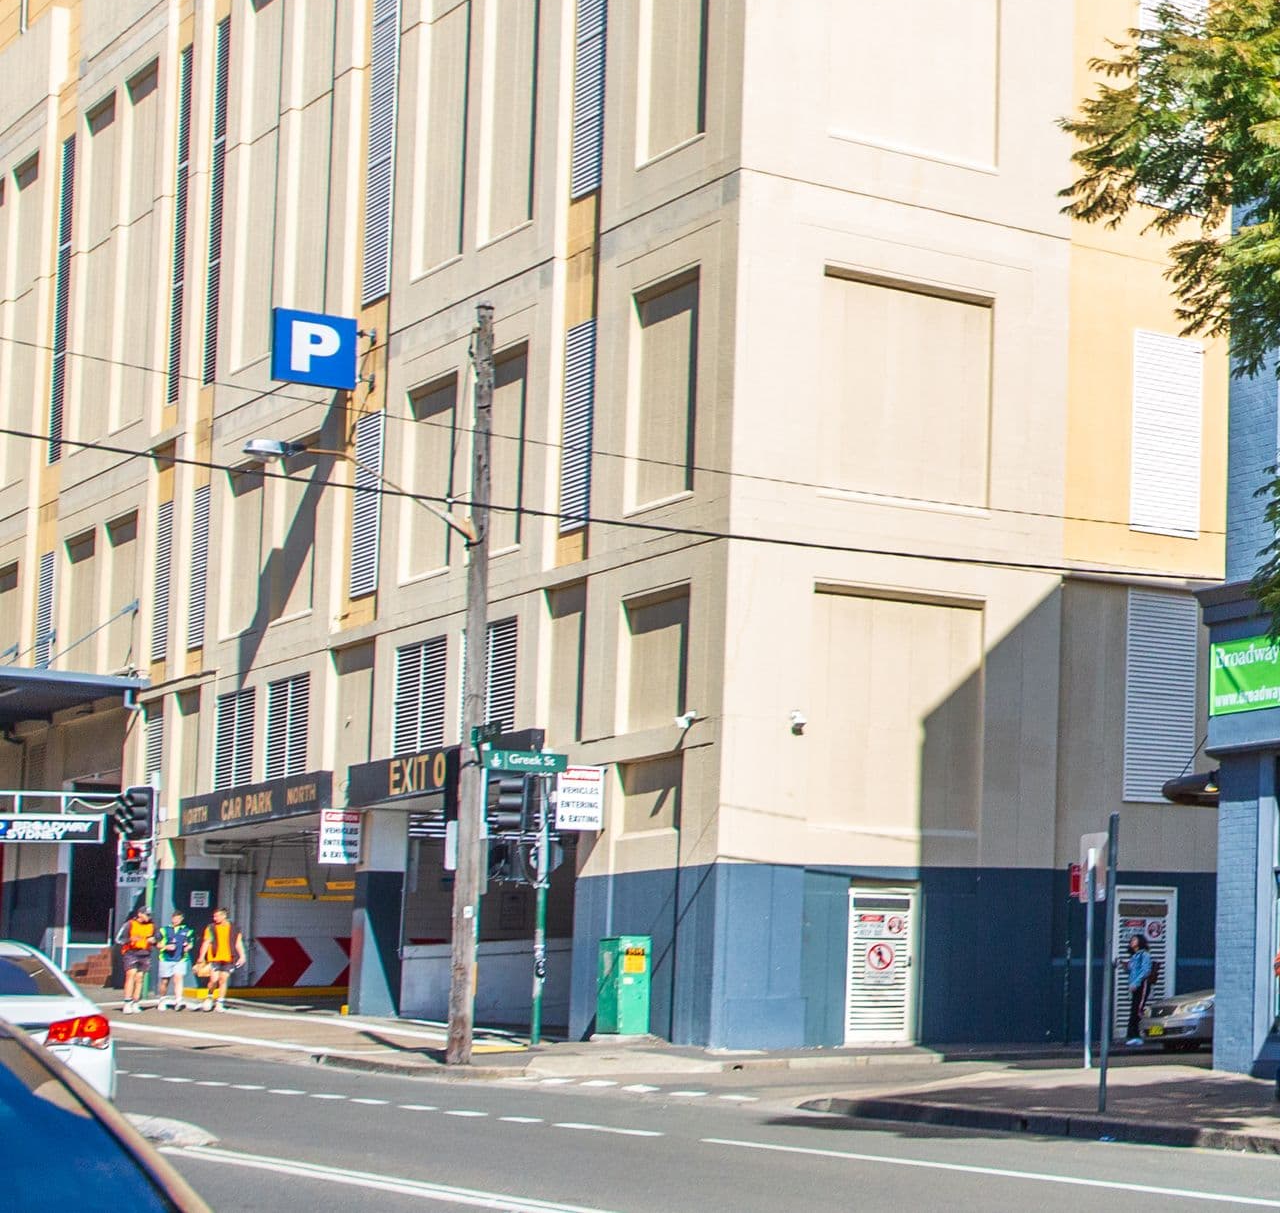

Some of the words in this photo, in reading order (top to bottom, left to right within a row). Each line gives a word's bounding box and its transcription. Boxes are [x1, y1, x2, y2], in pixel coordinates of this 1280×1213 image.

[290, 320, 341, 373] P
[1215, 643, 1280, 669] Broadway
[388, 754, 429, 796] EXIT
[508, 754, 542, 766] Greek
[221, 796, 242, 821] CAR
[244, 790, 273, 816] PARK
[286, 783, 317, 806] NORTH
